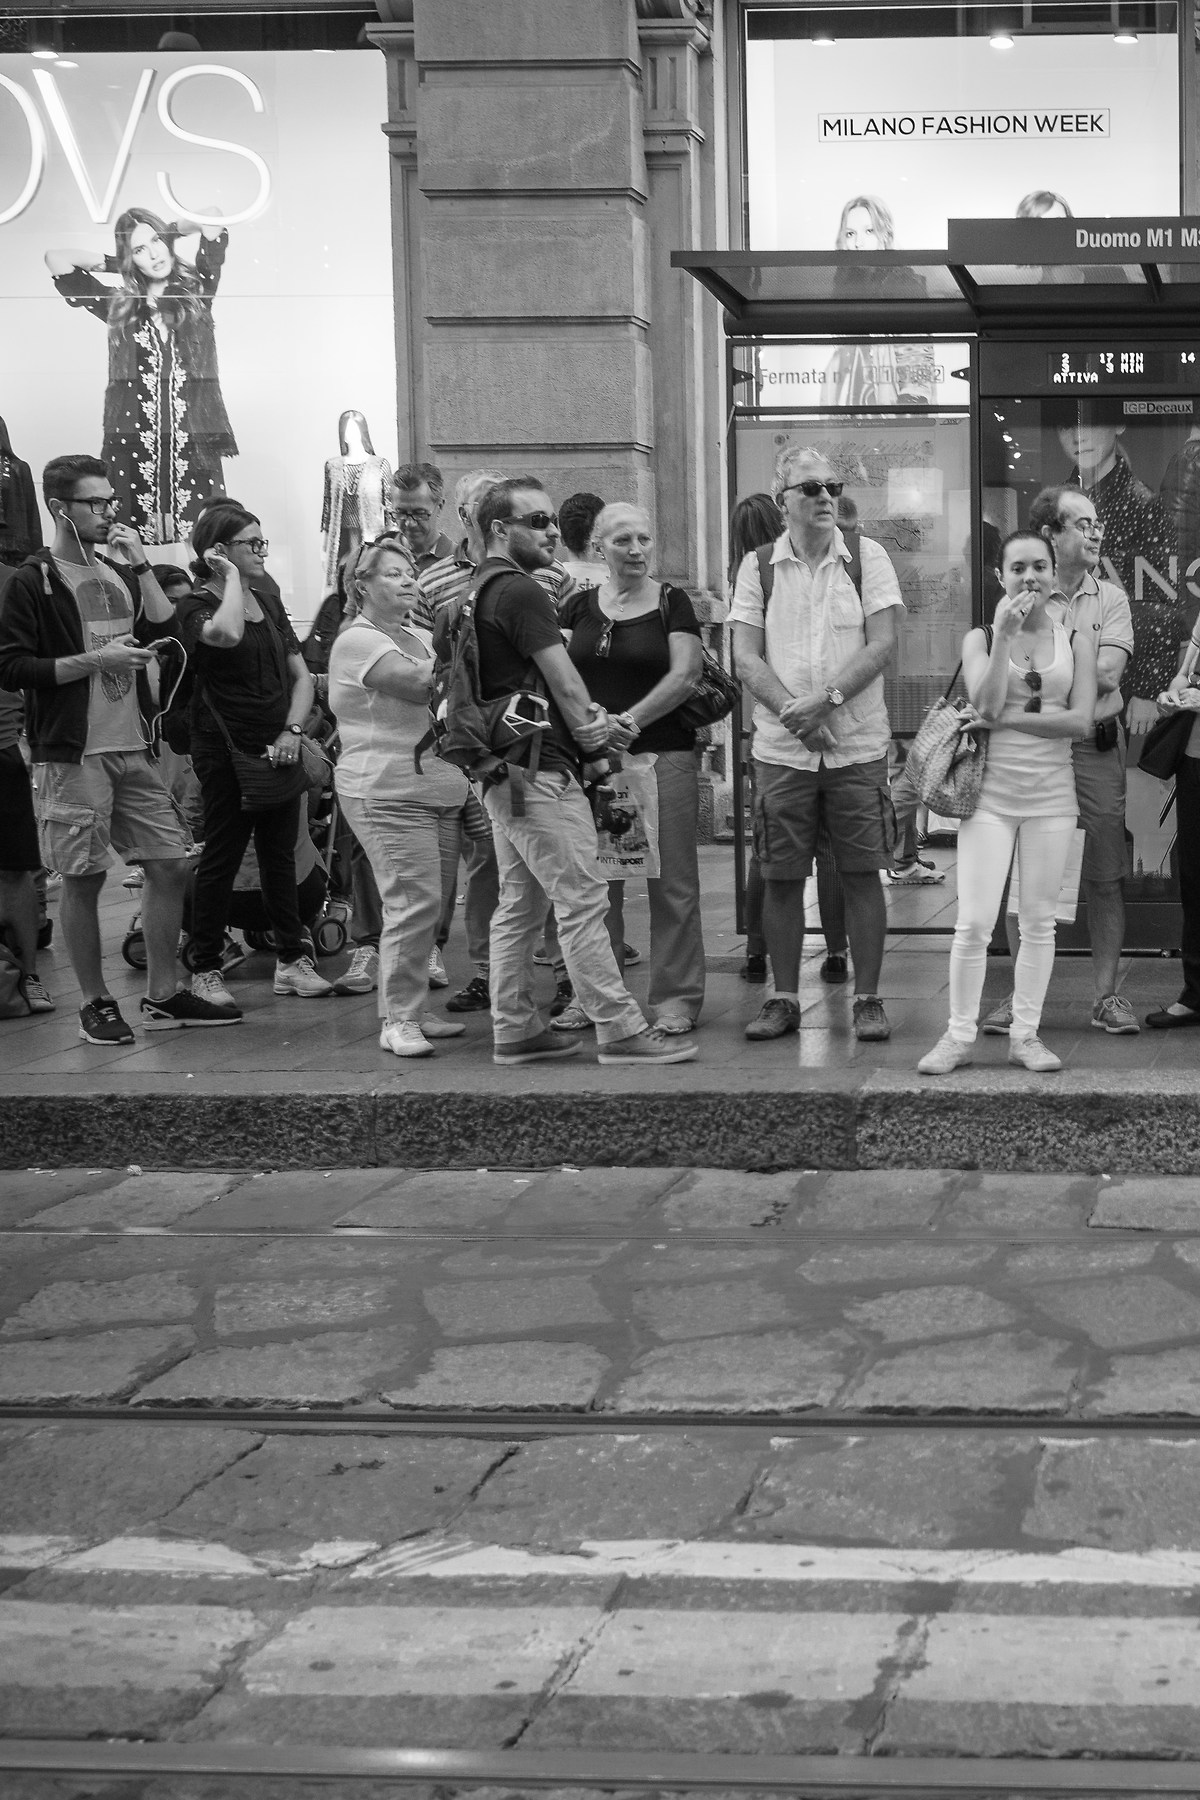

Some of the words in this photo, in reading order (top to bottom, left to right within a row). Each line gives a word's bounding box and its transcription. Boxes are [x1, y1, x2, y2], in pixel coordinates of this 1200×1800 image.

[822, 115, 916, 138] MILANO
[921, 113, 1029, 136] FASHION
[1033, 112, 1105, 134] WEEK
[1075, 227, 1141, 249] Duomo
[1146, 227, 1174, 248] M1
[1099, 352, 1115, 364] 17
[1120, 352, 1144, 364] MIN
[1180, 352, 1196, 364] 14
[1120, 362, 1144, 374] MIN
[762, 368, 827, 385] Fermata
[1053, 371, 1099, 383] ATTIVA
[1123, 401, 1193, 414] IGPDecaux
[600, 856, 645, 866] INTERSPORT
